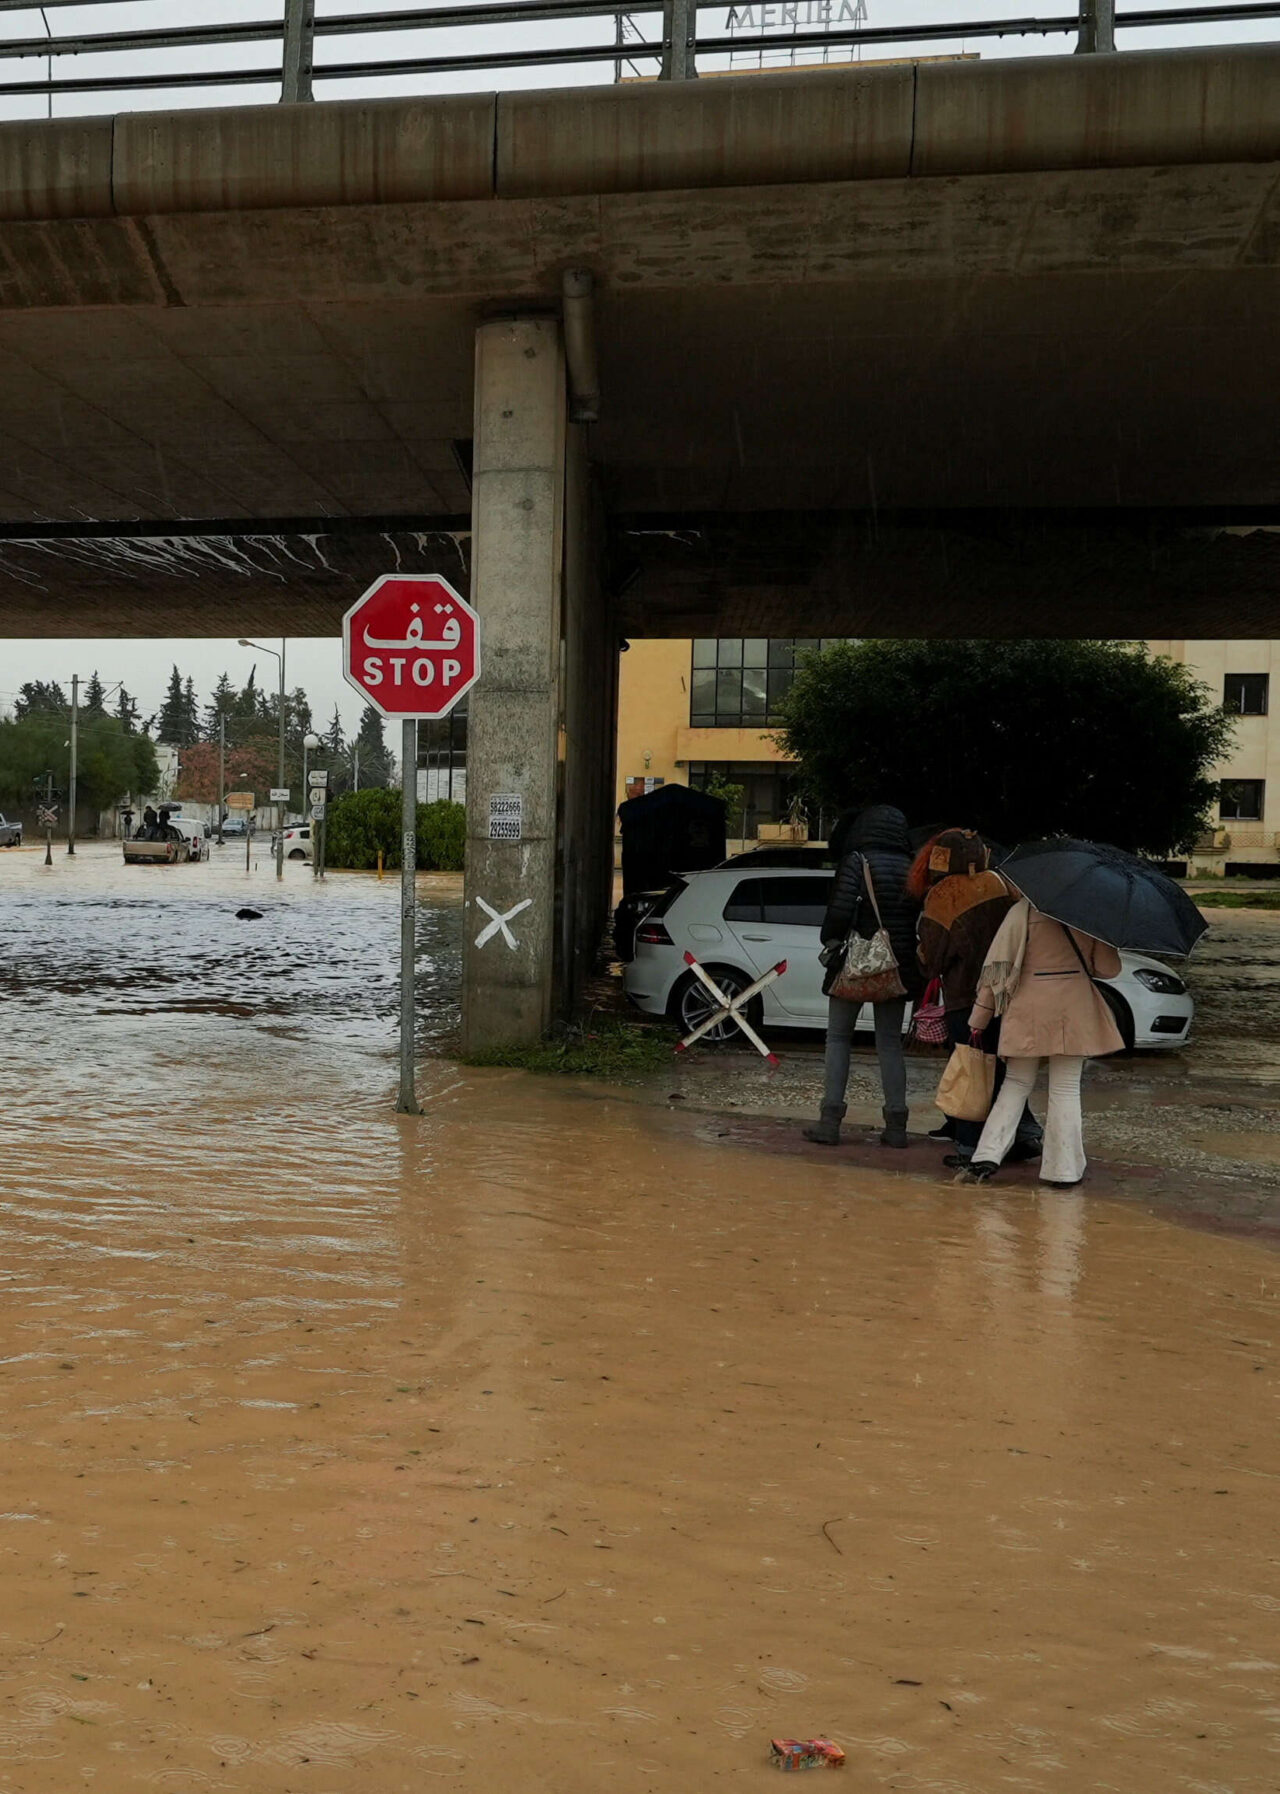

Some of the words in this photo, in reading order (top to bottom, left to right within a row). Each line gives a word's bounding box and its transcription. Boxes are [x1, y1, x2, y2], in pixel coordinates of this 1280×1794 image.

[725, 0, 868, 30] MERIEM
[363, 603, 461, 650] قف
[363, 657, 461, 687] STOP
